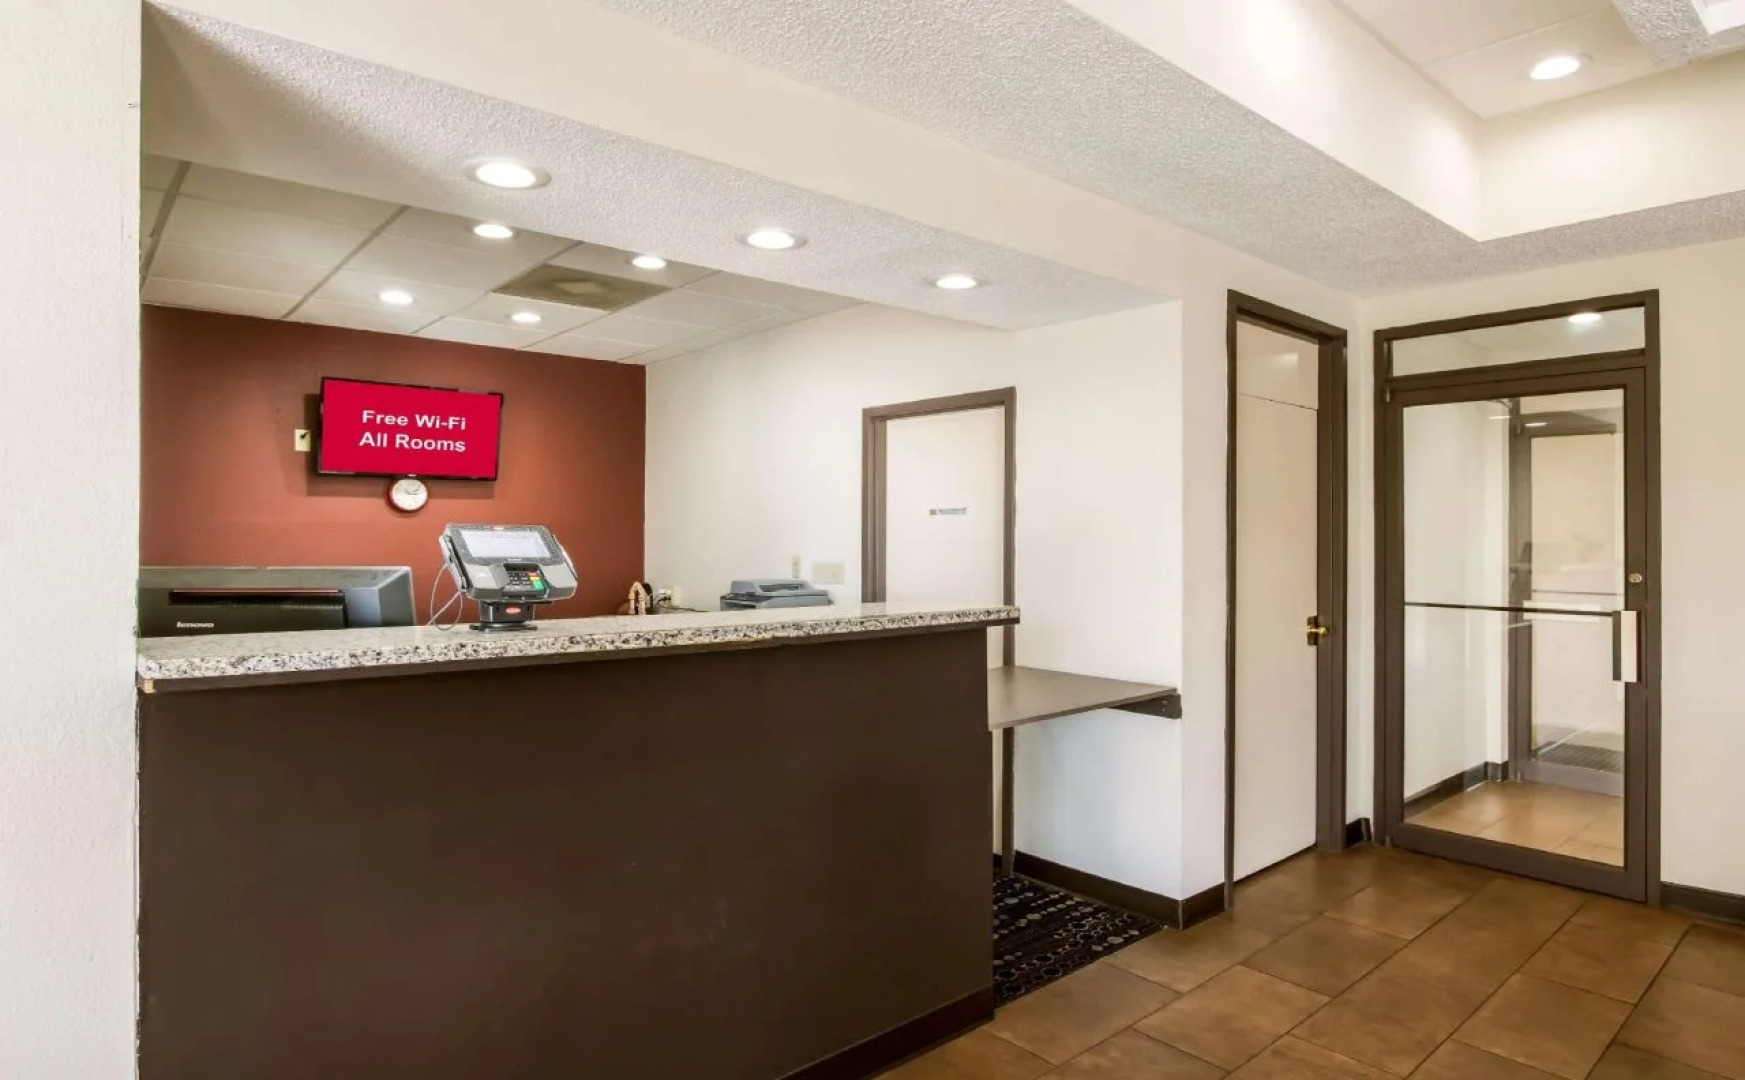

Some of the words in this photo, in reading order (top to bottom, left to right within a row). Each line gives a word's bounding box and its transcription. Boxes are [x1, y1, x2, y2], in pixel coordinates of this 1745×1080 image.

[362, 409, 409, 426] Free
[414, 414, 466, 431] Wi-Fi
[359, 431, 388, 448] All
[394, 433, 466, 453] Rooms
